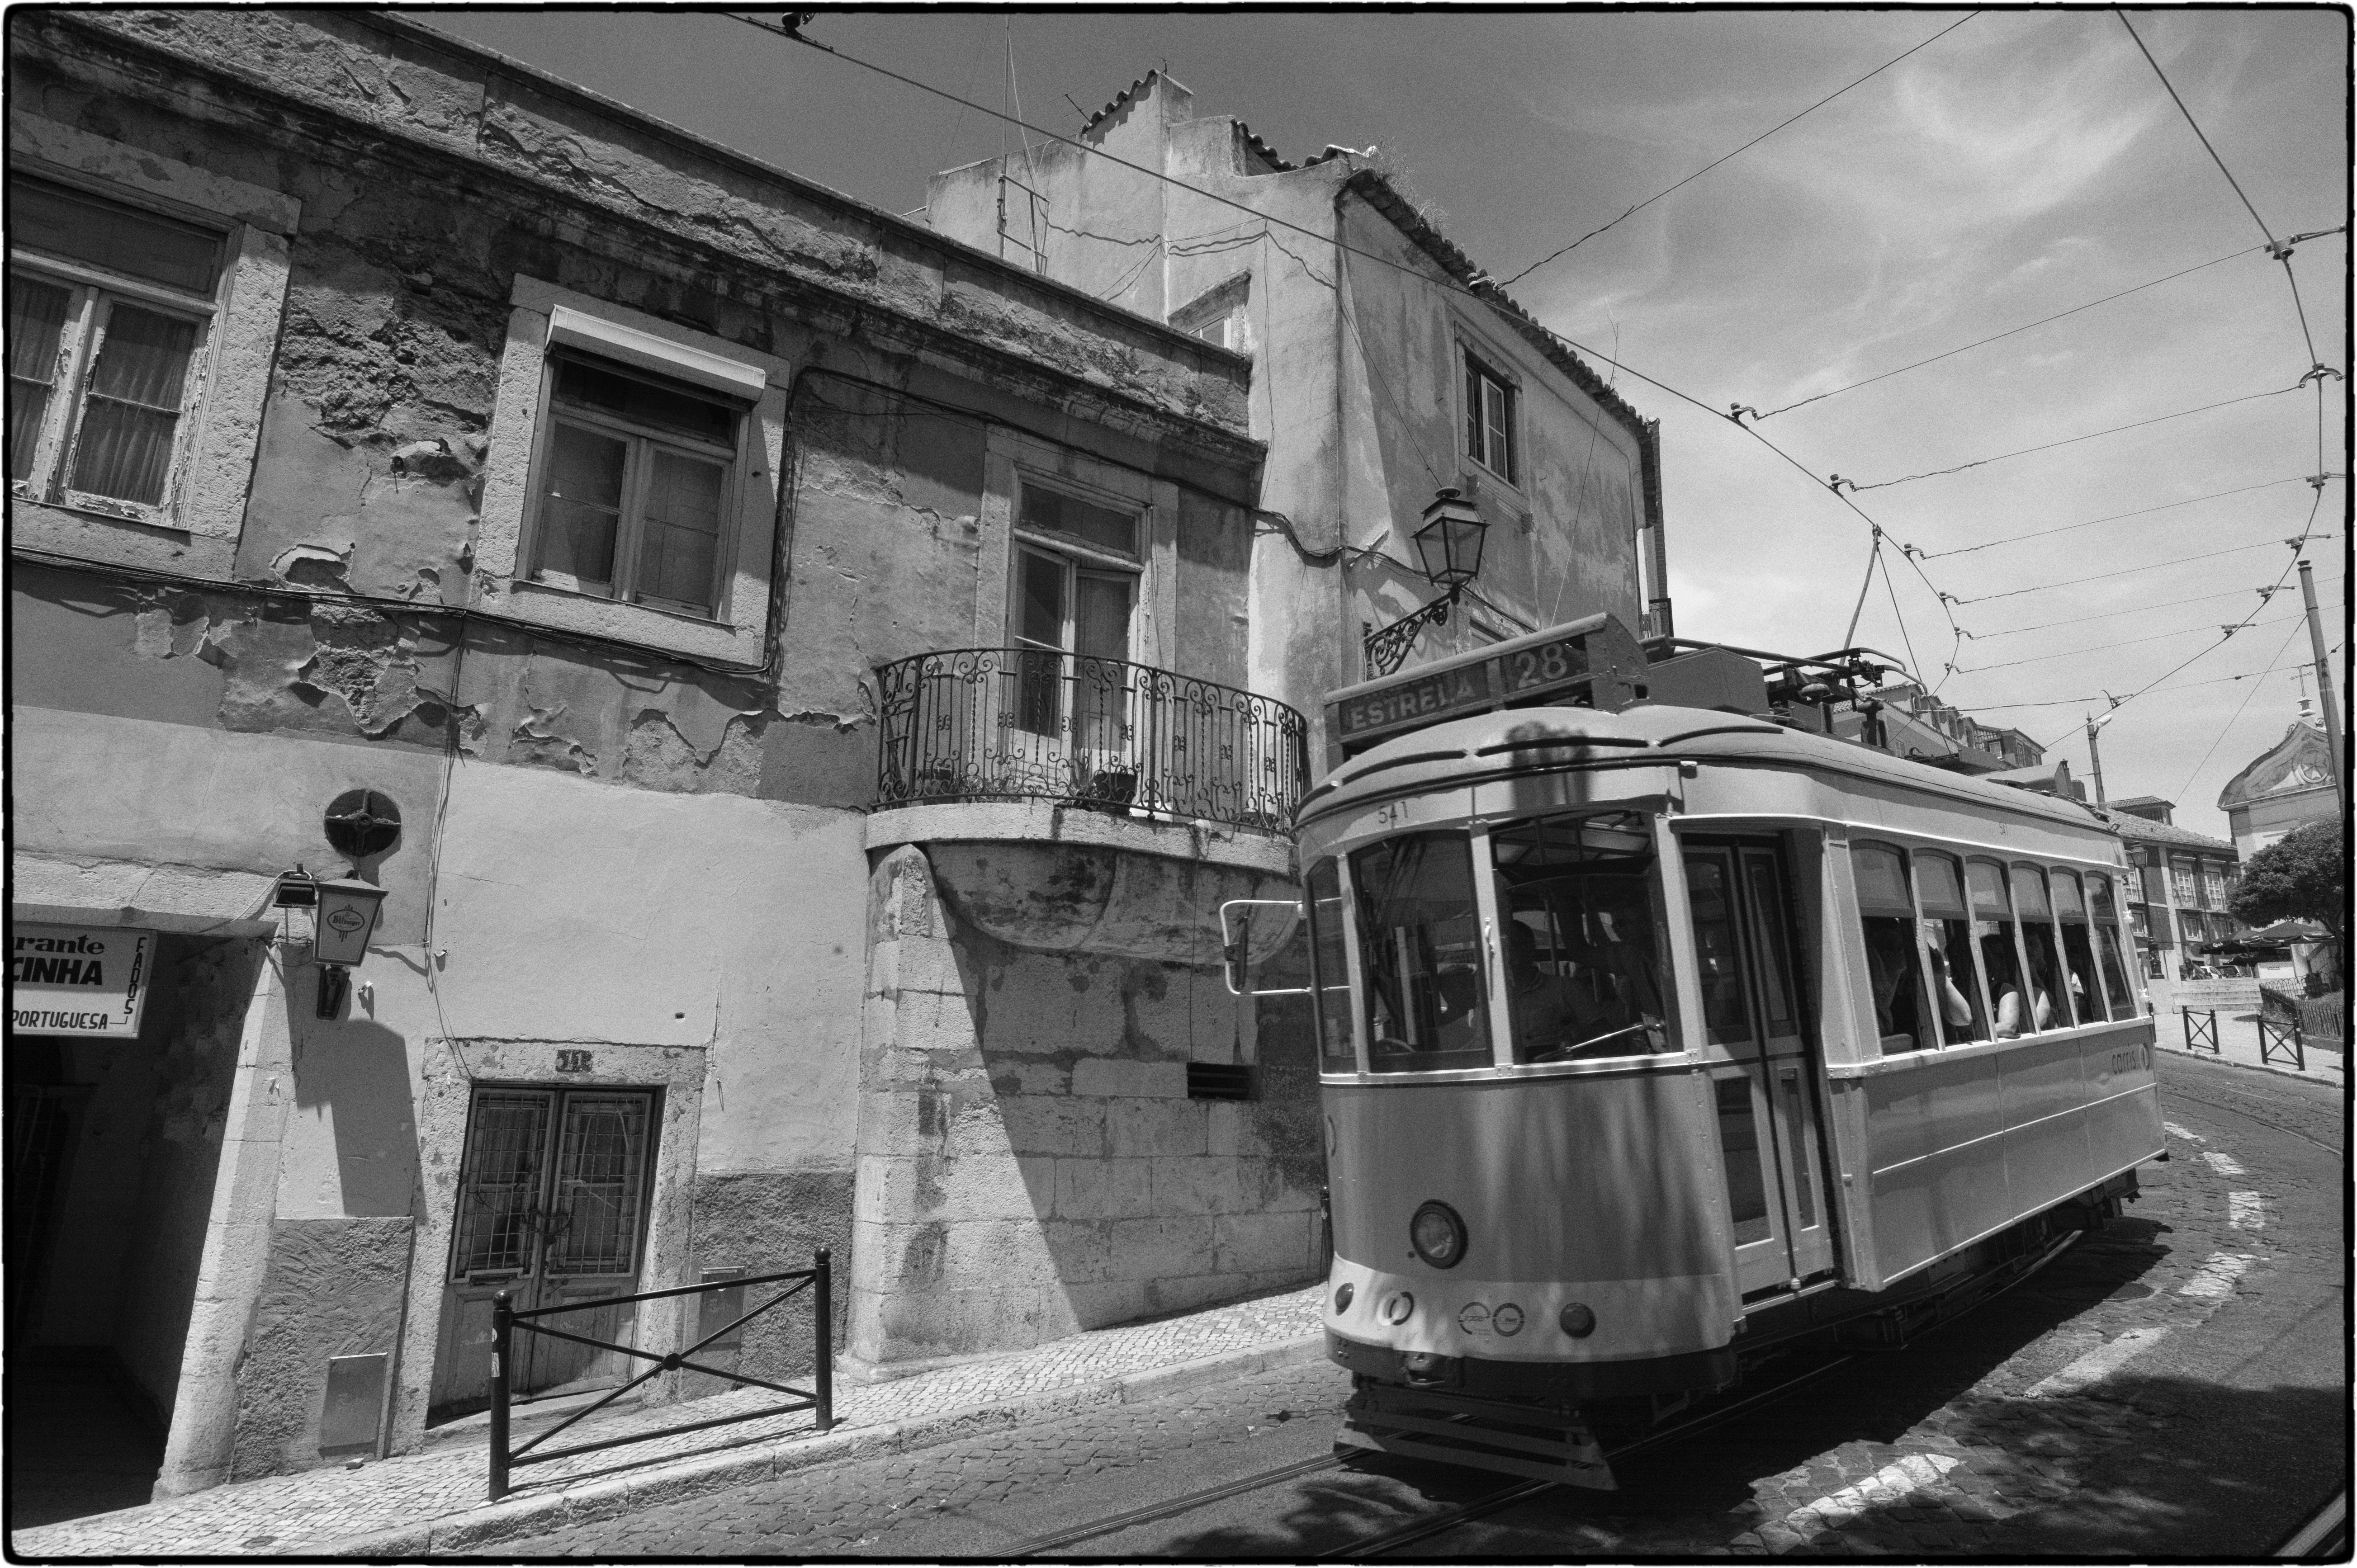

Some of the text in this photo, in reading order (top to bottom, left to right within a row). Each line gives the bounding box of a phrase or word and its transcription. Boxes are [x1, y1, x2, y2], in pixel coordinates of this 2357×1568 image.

[1515, 642, 1568, 689] 28
[1350, 676, 1476, 730] ESTRELA
[1378, 801, 1409, 824] 541
[13, 934, 105, 954] rante
[13, 957, 103, 986] CINHA
[123, 937, 147, 1015] FADOS
[13, 1010, 108, 1030] PORTUGUESA
[2112, 1043, 2136, 1075] carris
